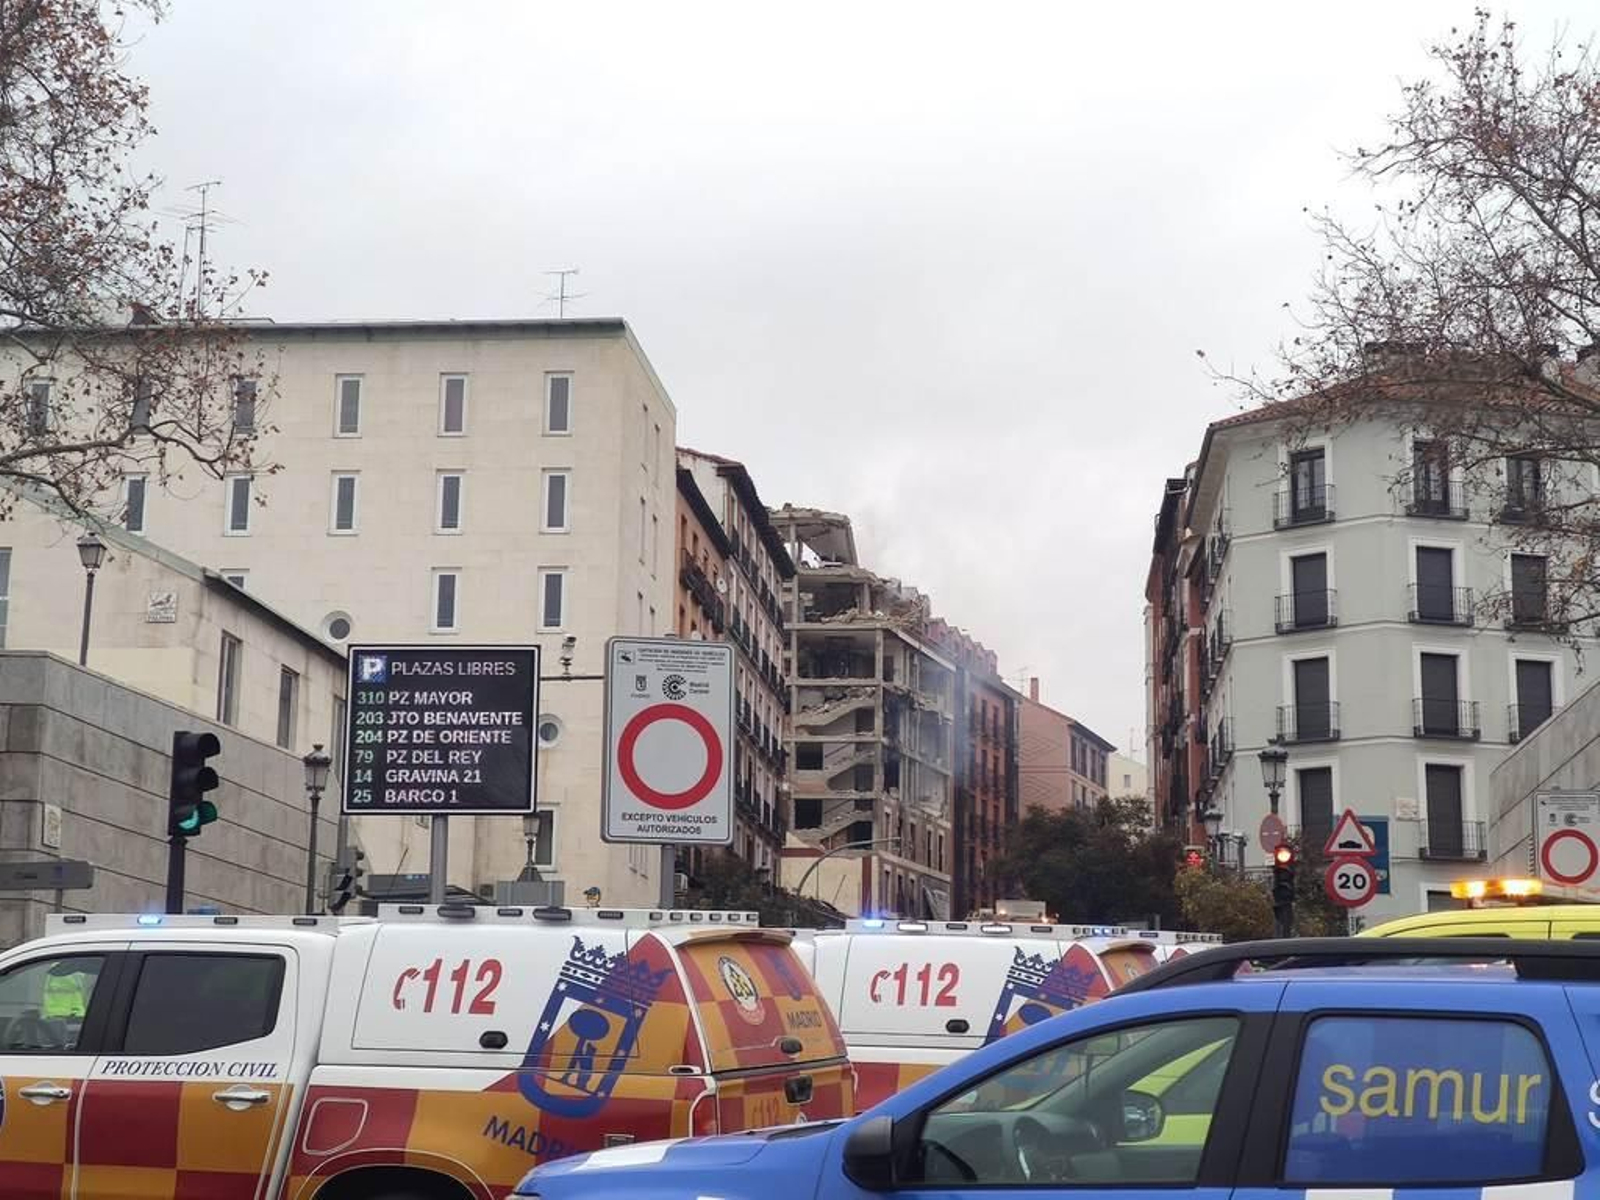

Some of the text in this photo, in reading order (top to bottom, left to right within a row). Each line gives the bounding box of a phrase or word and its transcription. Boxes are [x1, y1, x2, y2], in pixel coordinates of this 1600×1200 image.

[391, 661, 516, 676] PLAZAS LIBRES
[357, 691, 474, 705] 310 PZ MAYOR
[355, 711, 523, 725] 203 JTO BENAVENTE
[355, 730, 513, 744] 204 PZ DE ORIENTE
[355, 750, 482, 764] 79 PZ DEL REY
[354, 769, 482, 783] 14 GRAVINA 21
[353, 789, 460, 803] 25 BARCO 1
[621, 811, 664, 823] EXCEPTO
[636, 824, 702, 835] AUTORIZADOS
[1338, 873, 1367, 890] 20
[423, 958, 503, 1015] 112
[893, 962, 960, 1007] 112
[101, 1060, 278, 1078] PROTECCION CIVIL
[1319, 1063, 1542, 1124] samur
